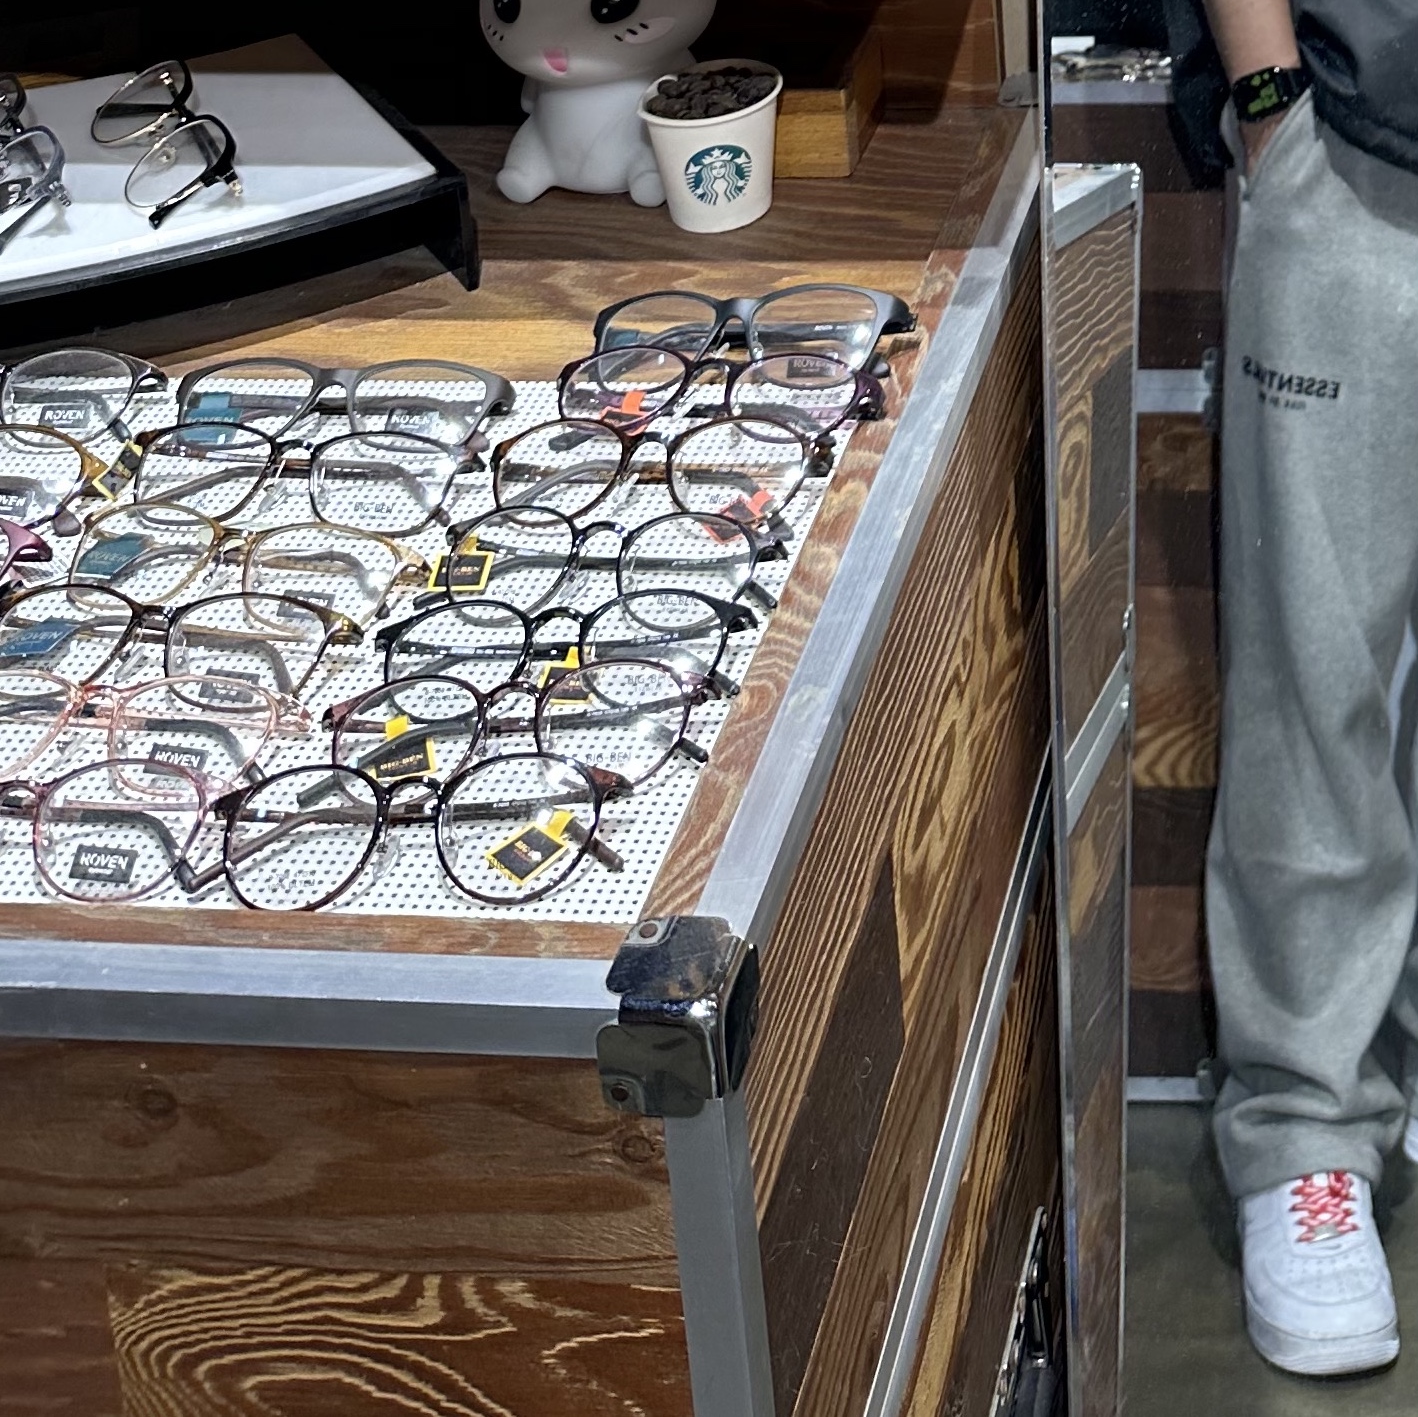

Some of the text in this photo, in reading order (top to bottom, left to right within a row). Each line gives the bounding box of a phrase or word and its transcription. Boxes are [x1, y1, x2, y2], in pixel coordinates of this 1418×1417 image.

[44, 409, 85, 421] ROVEN
[154, 750, 201, 768] ROVEN
[80, 852, 129, 870] ROVEN
